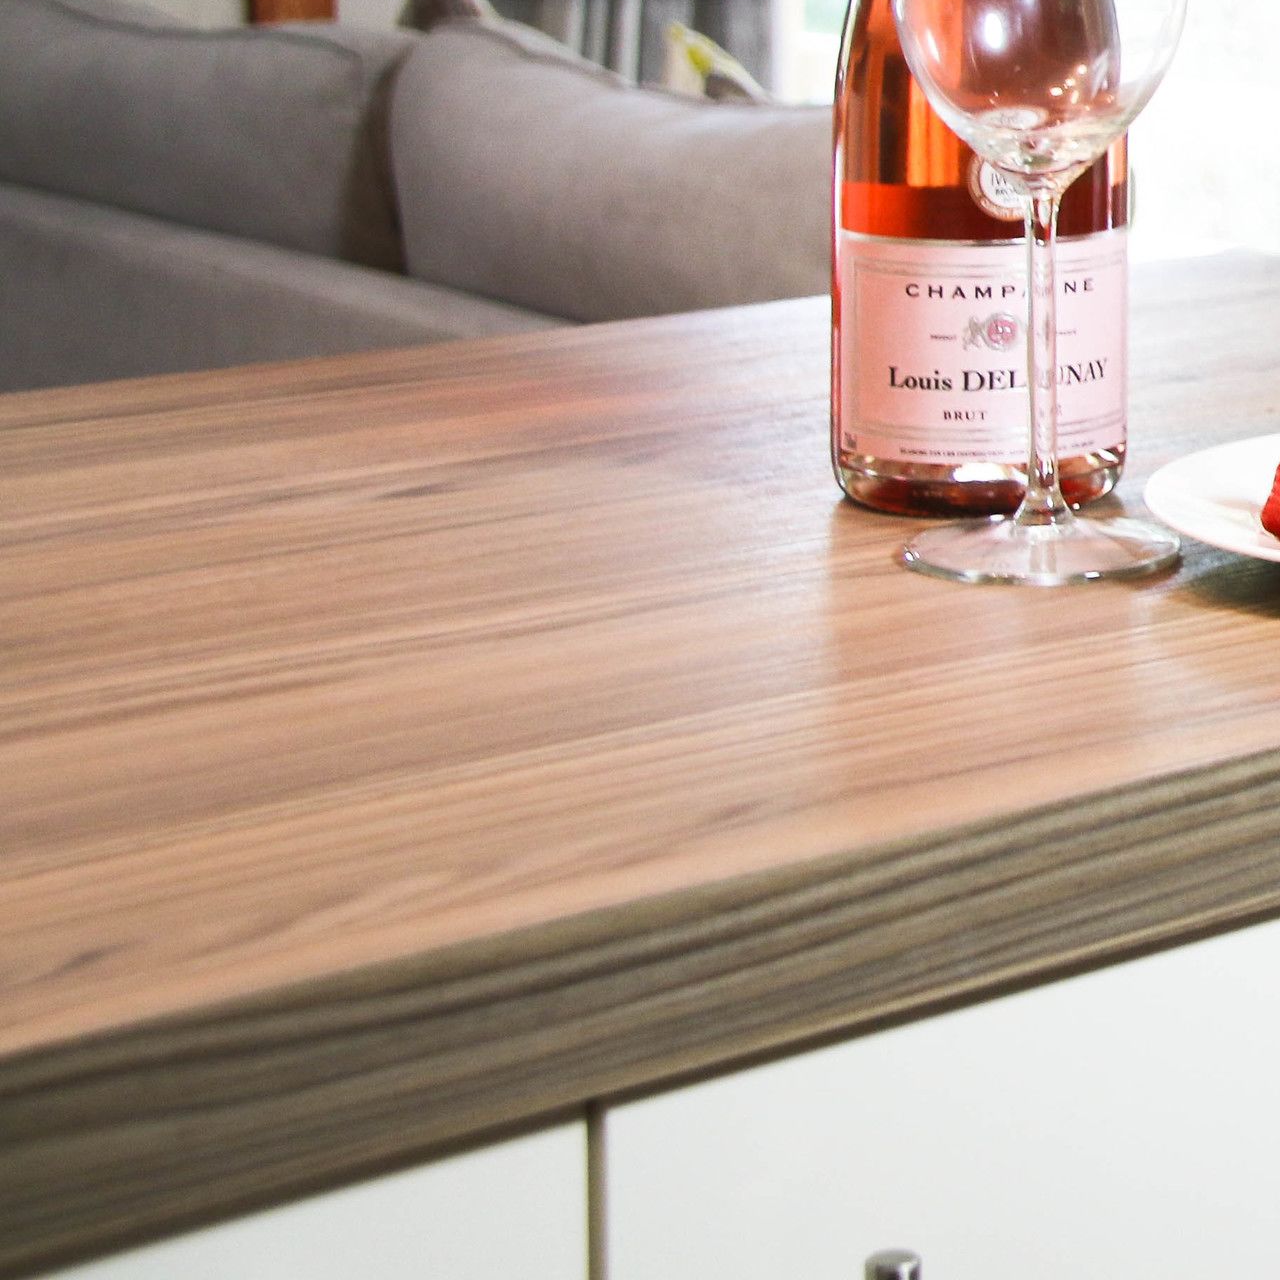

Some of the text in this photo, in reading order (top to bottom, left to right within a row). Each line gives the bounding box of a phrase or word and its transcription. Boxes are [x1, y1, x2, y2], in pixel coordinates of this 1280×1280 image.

[905, 278, 1095, 300] CHAMPNE
[888, 357, 1108, 393] Louis DELNAY
[943, 410, 987, 422] BRUT
